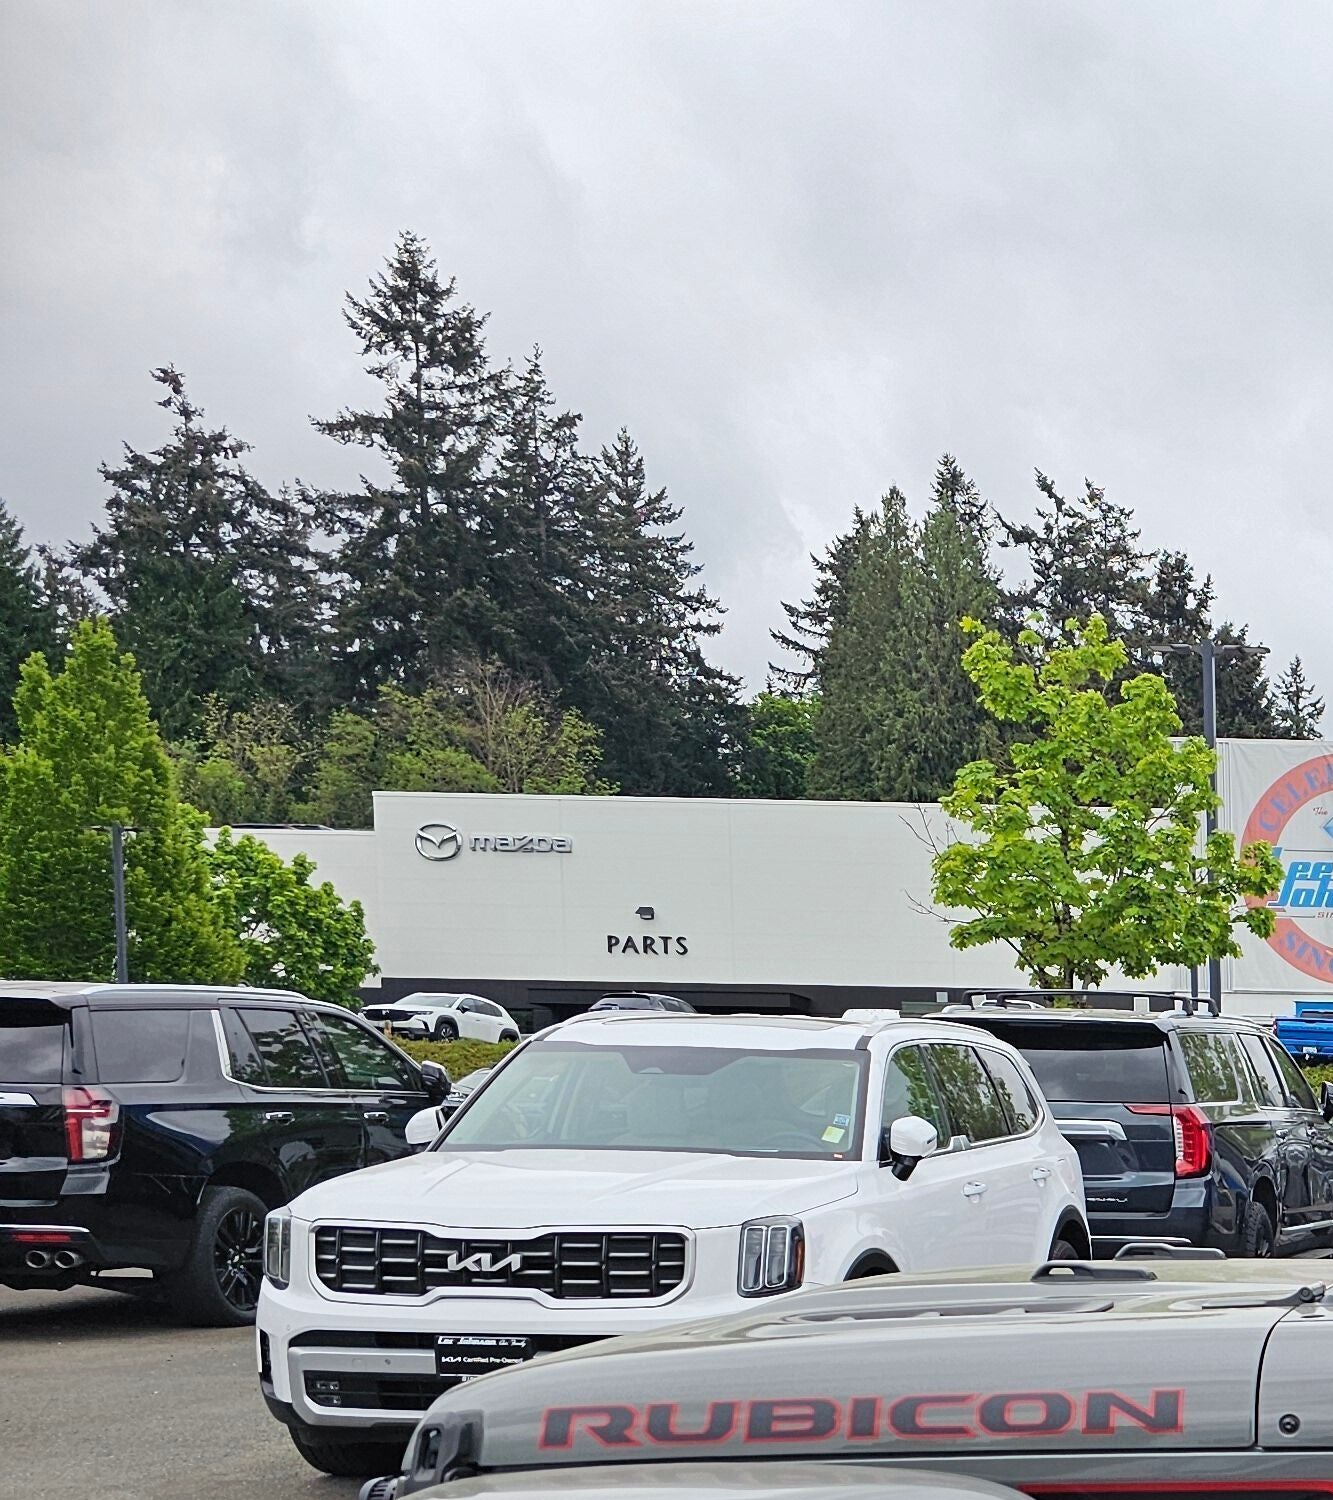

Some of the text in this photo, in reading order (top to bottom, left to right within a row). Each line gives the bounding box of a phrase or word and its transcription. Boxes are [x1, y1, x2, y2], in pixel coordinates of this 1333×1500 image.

[469, 833, 573, 853] mazda
[607, 935, 688, 956] PARTS
[538, 1387, 1187, 1449] RUBICON
